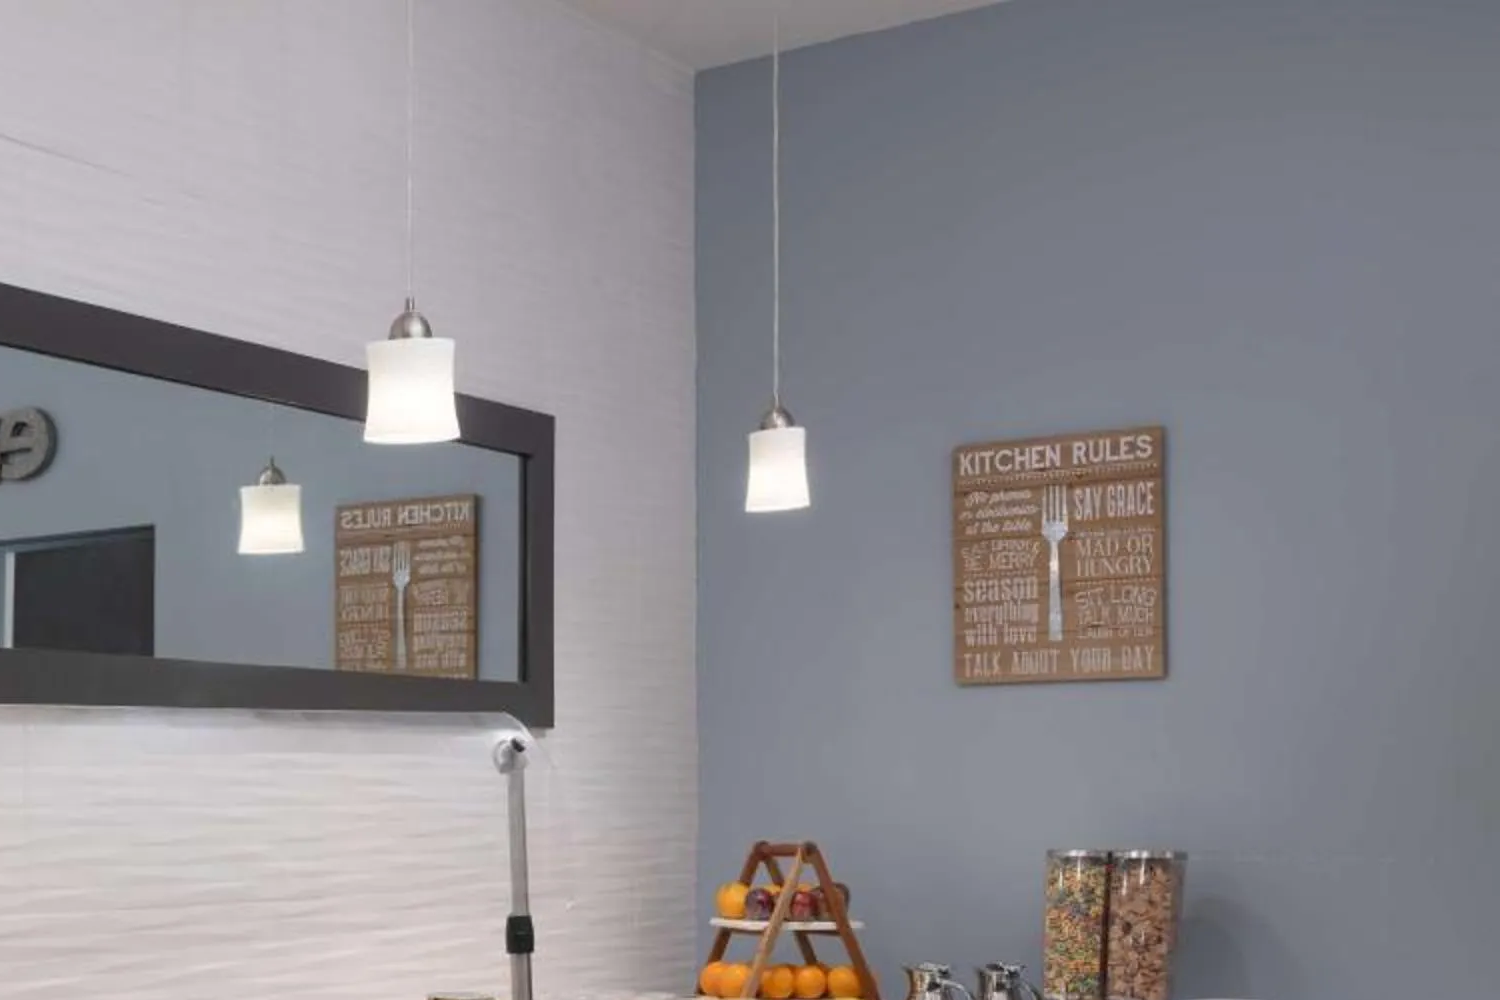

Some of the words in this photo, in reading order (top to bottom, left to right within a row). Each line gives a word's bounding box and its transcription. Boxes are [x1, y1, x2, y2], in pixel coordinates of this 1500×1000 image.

[959, 444, 1062, 477] KITCHEN
[1072, 434, 1154, 466] RULES
[1075, 484, 1102, 521] SAY
[1107, 481, 1155, 518] GRACE
[1076, 538, 1120, 558] MAD
[1125, 533, 1154, 556] OR
[989, 551, 1036, 570] MERRY
[1077, 555, 1152, 577] HUNGRY
[963, 651, 1001, 678] TALK
[1069, 647, 1111, 673] YOUR
[1121, 644, 1155, 671] DAY
